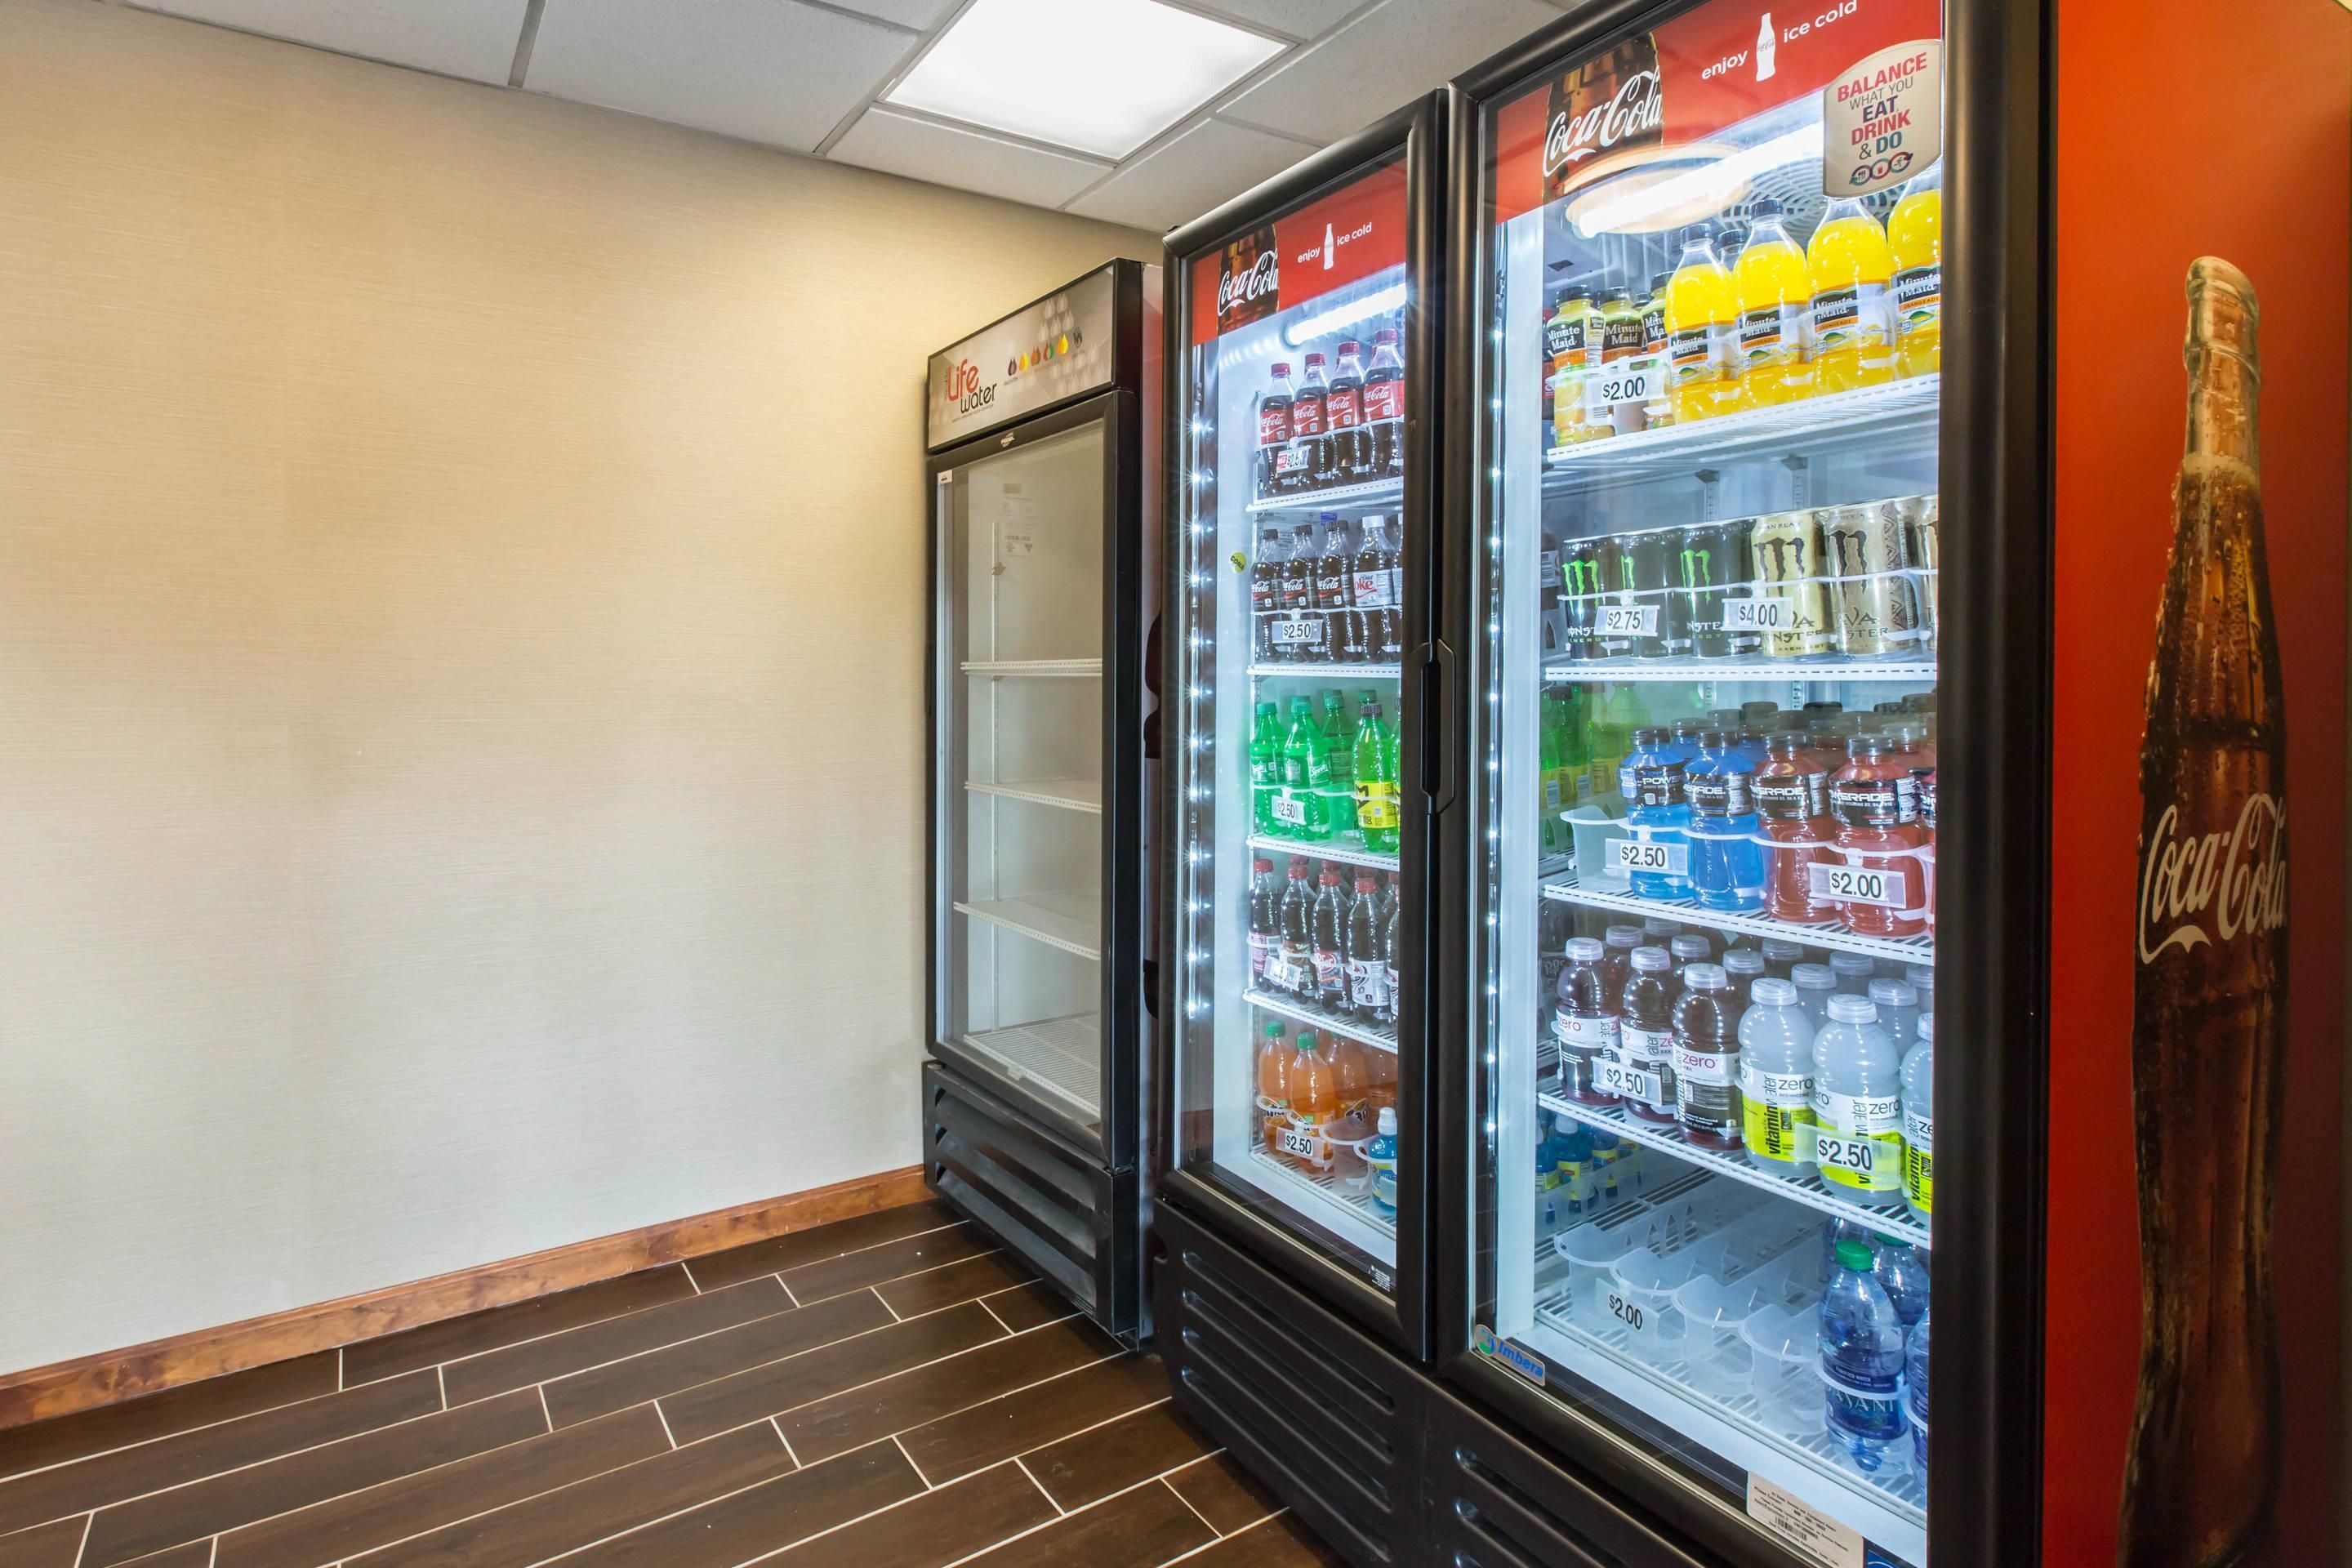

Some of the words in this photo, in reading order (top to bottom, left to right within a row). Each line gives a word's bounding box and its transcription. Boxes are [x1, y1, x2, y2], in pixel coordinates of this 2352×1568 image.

[1701, 50, 1747, 80] enjoy
[1784, 20, 1810, 43] ice
[1815, 0, 1857, 29] cold
[1838, 52, 1927, 103] BALANCE
[1850, 88, 1884, 111] WHAT
[1888, 76, 1913, 95] YOU
[1544, 65, 1664, 176] Coca-Cola
[1851, 109, 1911, 145] DRINK
[1859, 143, 1872, 160] &
[1876, 131, 1902, 154] DO
[1297, 247, 1321, 264] enjoy
[1337, 232, 1350, 247] ice
[1352, 221, 1372, 240] cold
[1217, 247, 1279, 316] Coca-Cola
[1606, 323, 1643, 336] Minute
[1645, 316, 1665, 328] Minu
[1548, 326, 1580, 341] Minute
[1552, 339, 1577, 350] Maid
[1611, 333, 1638, 345] Maid
[947, 359, 979, 402] Life
[1602, 376, 1646, 401] $2.00
[960, 383, 997, 414] water
[1607, 610, 1641, 630] $2.75
[1739, 604, 1778, 626] $4.00
[1283, 622, 1311, 639] $2.50
[1844, 627, 1889, 641] STER
[1277, 801, 1295, 818] $2.50
[1621, 845, 1665, 867] $2.50
[1831, 872, 1882, 899] $2.00
[2139, 793, 2286, 964] Coca-Cola
[1558, 1016, 1582, 1031] zero
[1659, 1036, 1673, 1048] ze
[1682, 1053, 1716, 1069] zero
[1606, 1067, 1643, 1095] $2.50
[1778, 1078, 1813, 1091] zero
[1869, 1099, 1900, 1115] zero
[1918, 1120, 1933, 1135] ze
[1285, 1134, 1312, 1155] $2.50
[1818, 1138, 1872, 1171] $2.50
[1609, 1294, 1643, 1330] $2.00
[1498, 1339, 1544, 1379] Imbera
